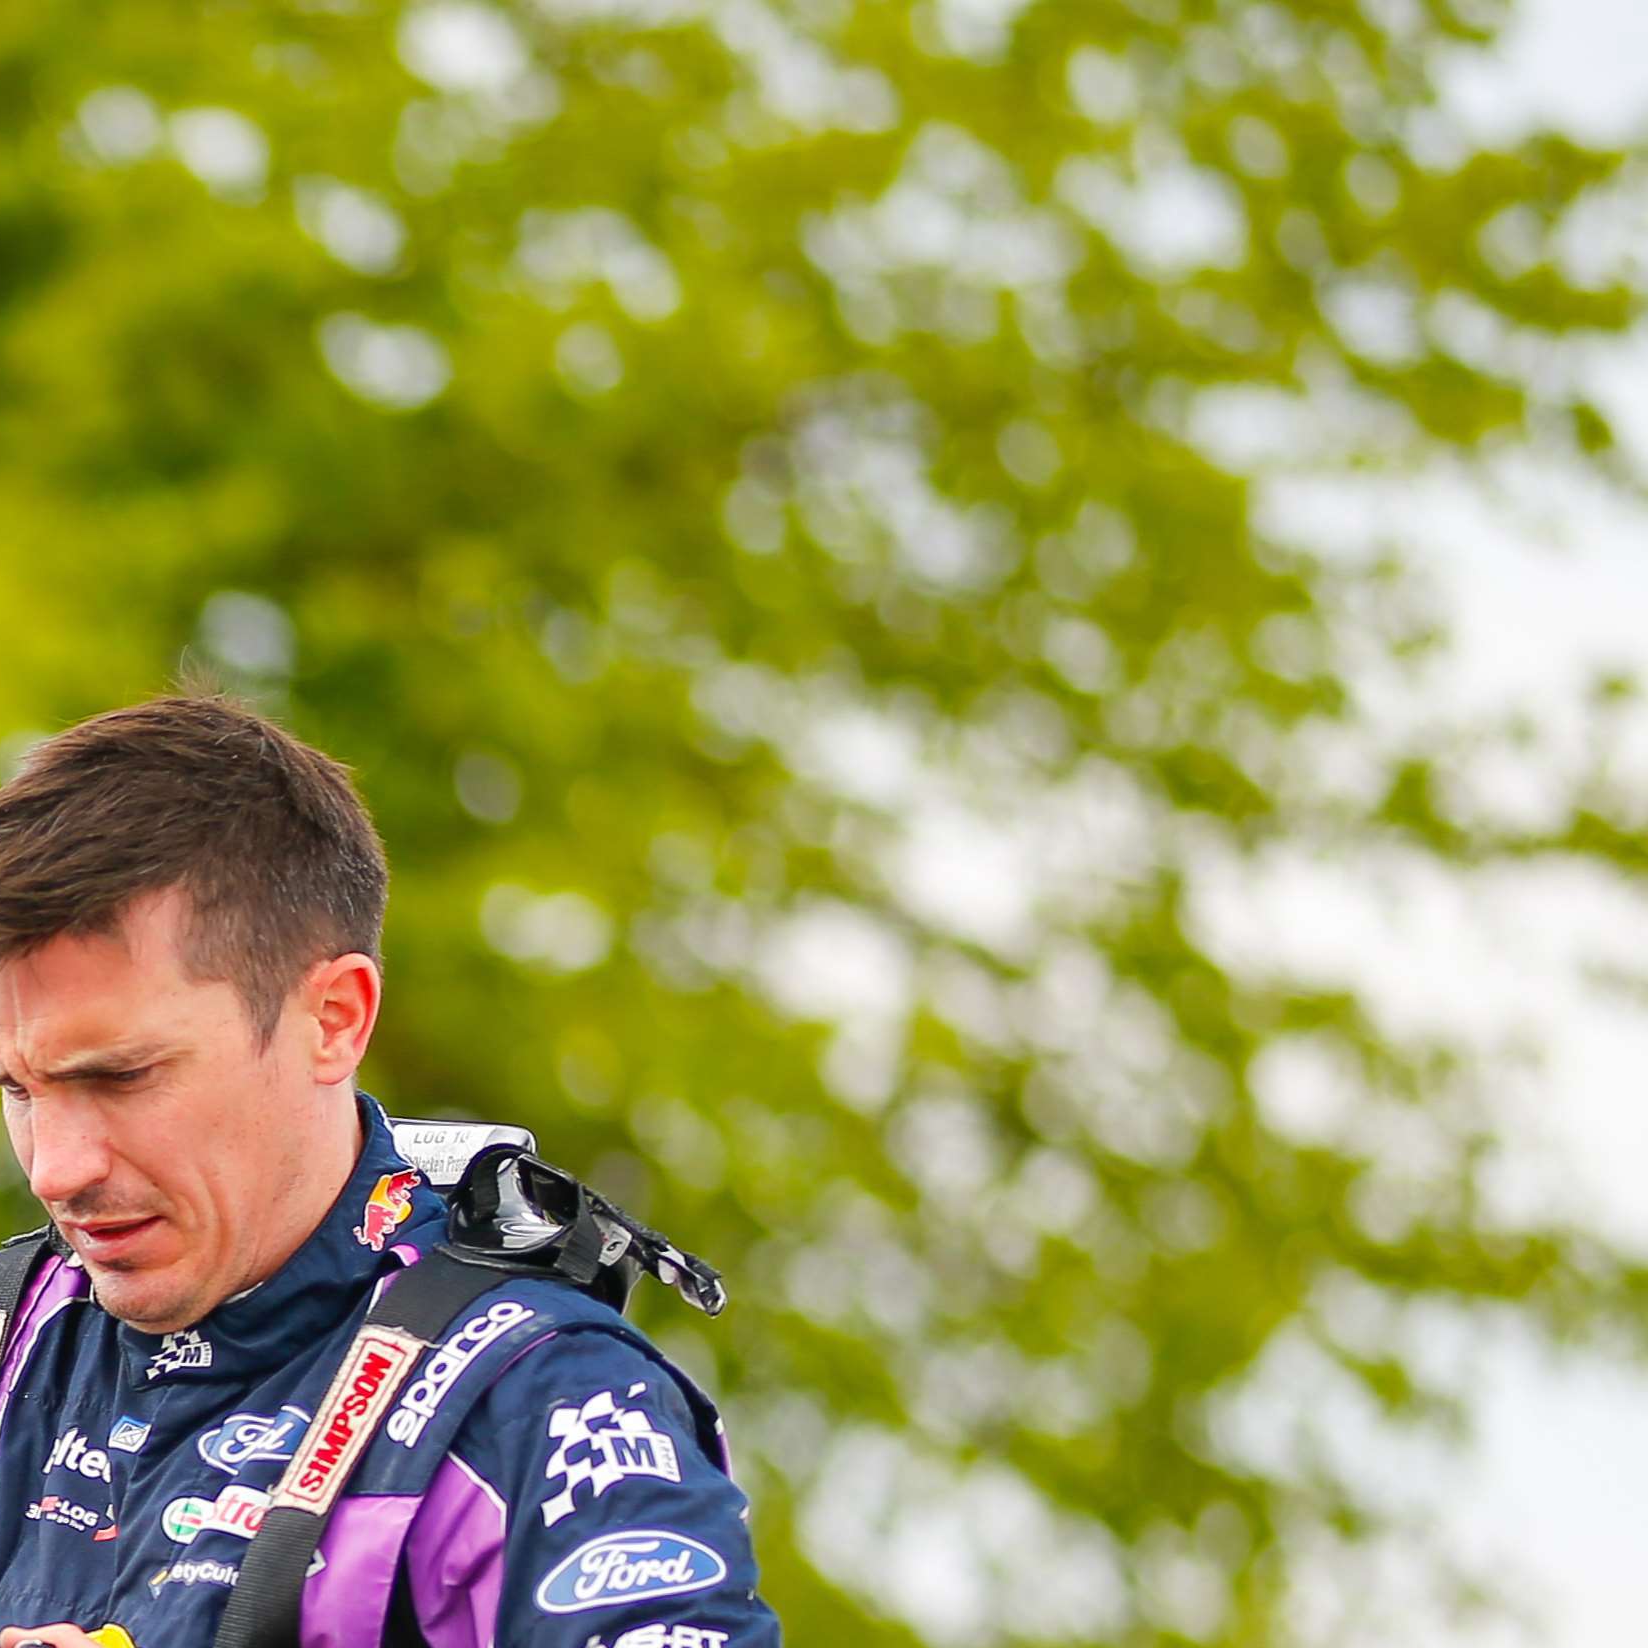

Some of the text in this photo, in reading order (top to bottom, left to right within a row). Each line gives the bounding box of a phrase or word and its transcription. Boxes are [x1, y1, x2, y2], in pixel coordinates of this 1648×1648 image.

[300, 1353, 392, 1492] SIMPSON
[387, 1302, 535, 1448] sparco
[575, 1539, 695, 1599] Ford
